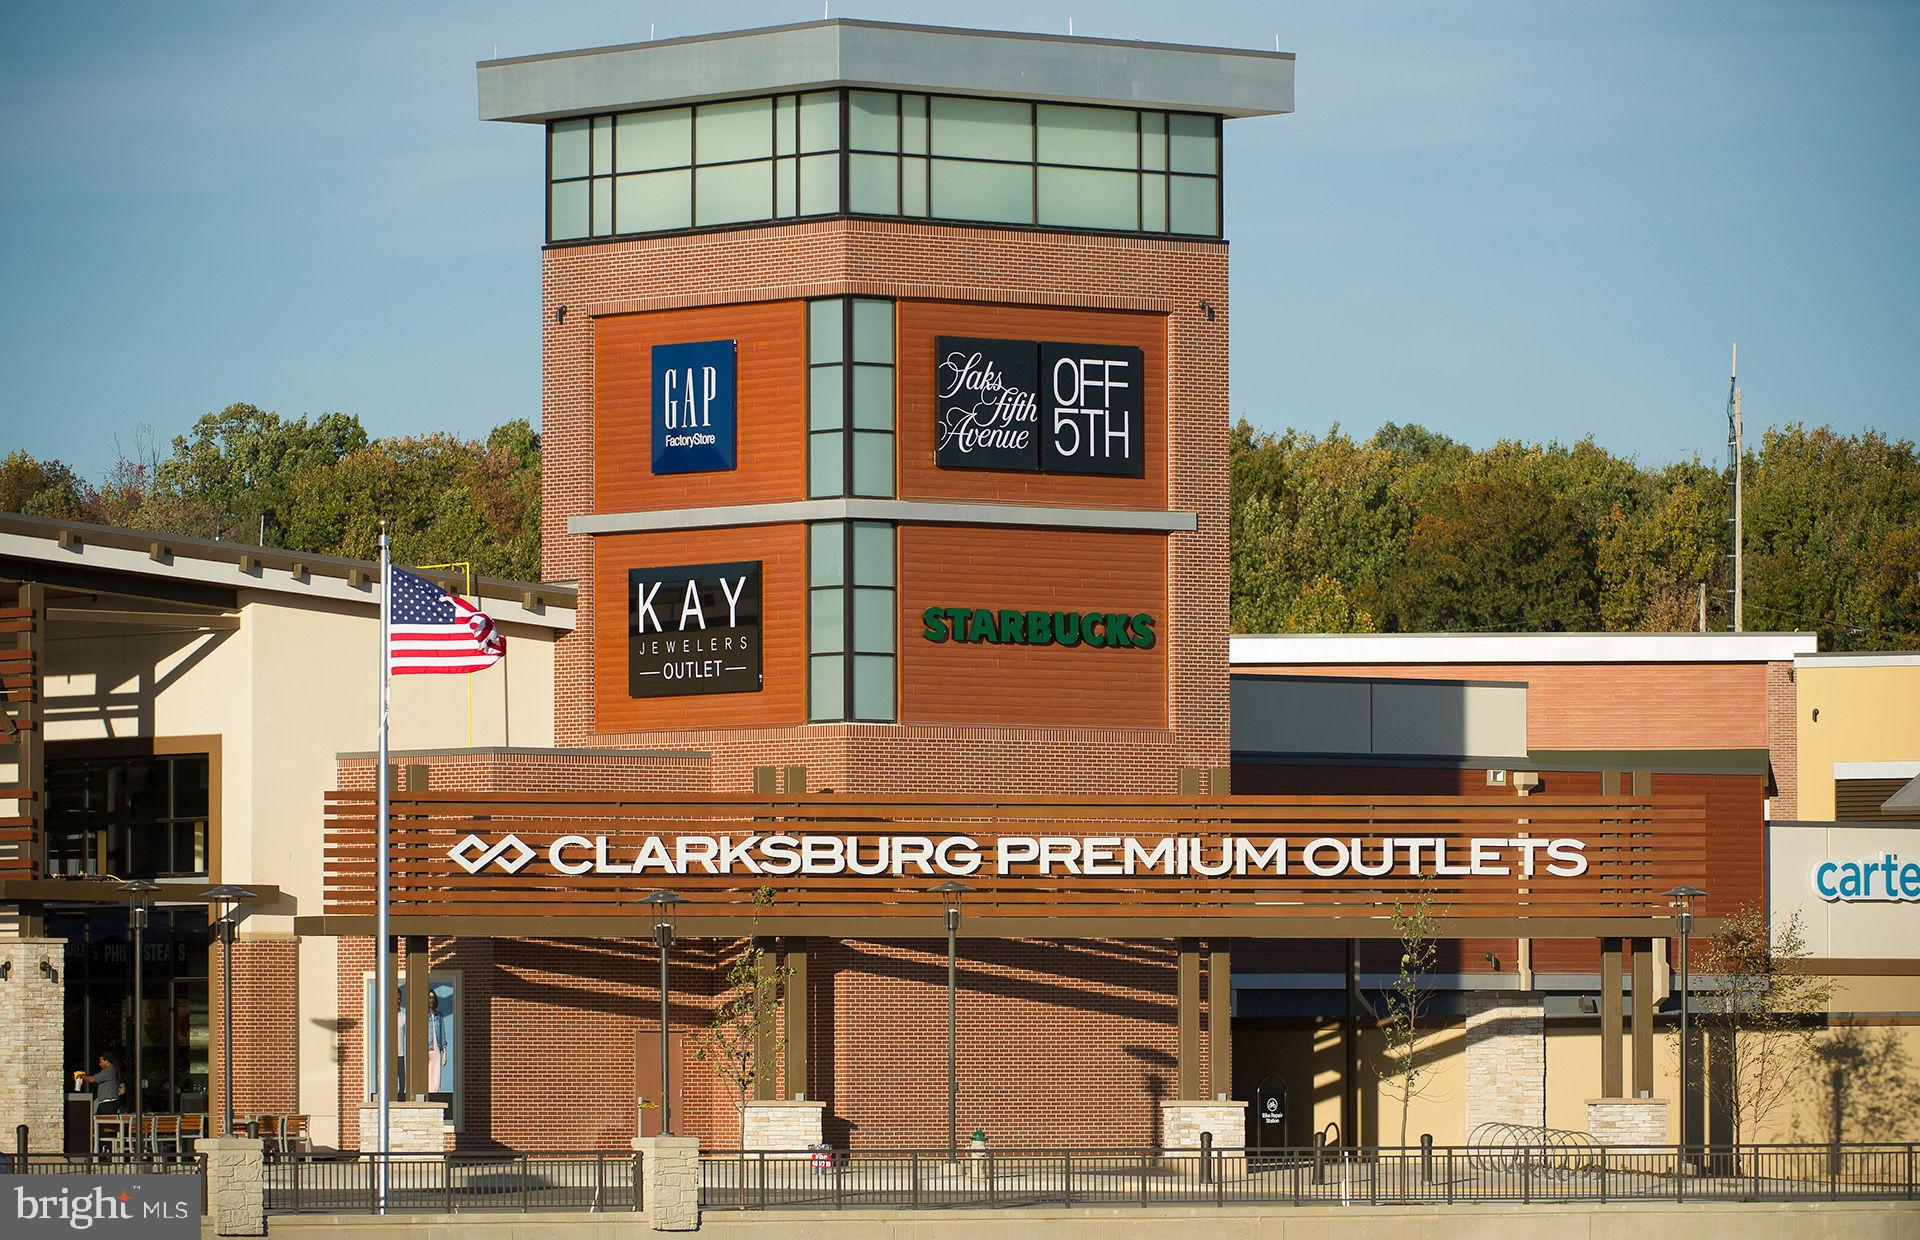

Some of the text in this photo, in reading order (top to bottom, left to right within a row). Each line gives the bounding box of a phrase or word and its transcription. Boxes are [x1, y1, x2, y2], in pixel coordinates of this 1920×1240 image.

[664, 366, 717, 430] GAP
[938, 351, 1003, 399] Saks
[1053, 357, 1129, 408] OFF
[938, 406, 1030, 453] Avenue
[1054, 407, 1130, 459] 5TH
[638, 576, 747, 634] KAY
[923, 606, 1155, 648] STARBUCKS
[639, 636, 748, 655] JEWELERS
[663, 659, 723, 680] OUTLET
[548, 834, 1588, 877] CLARKSBURG PREMIUM OUTLETS
[143, 943, 186, 961] STEAS
